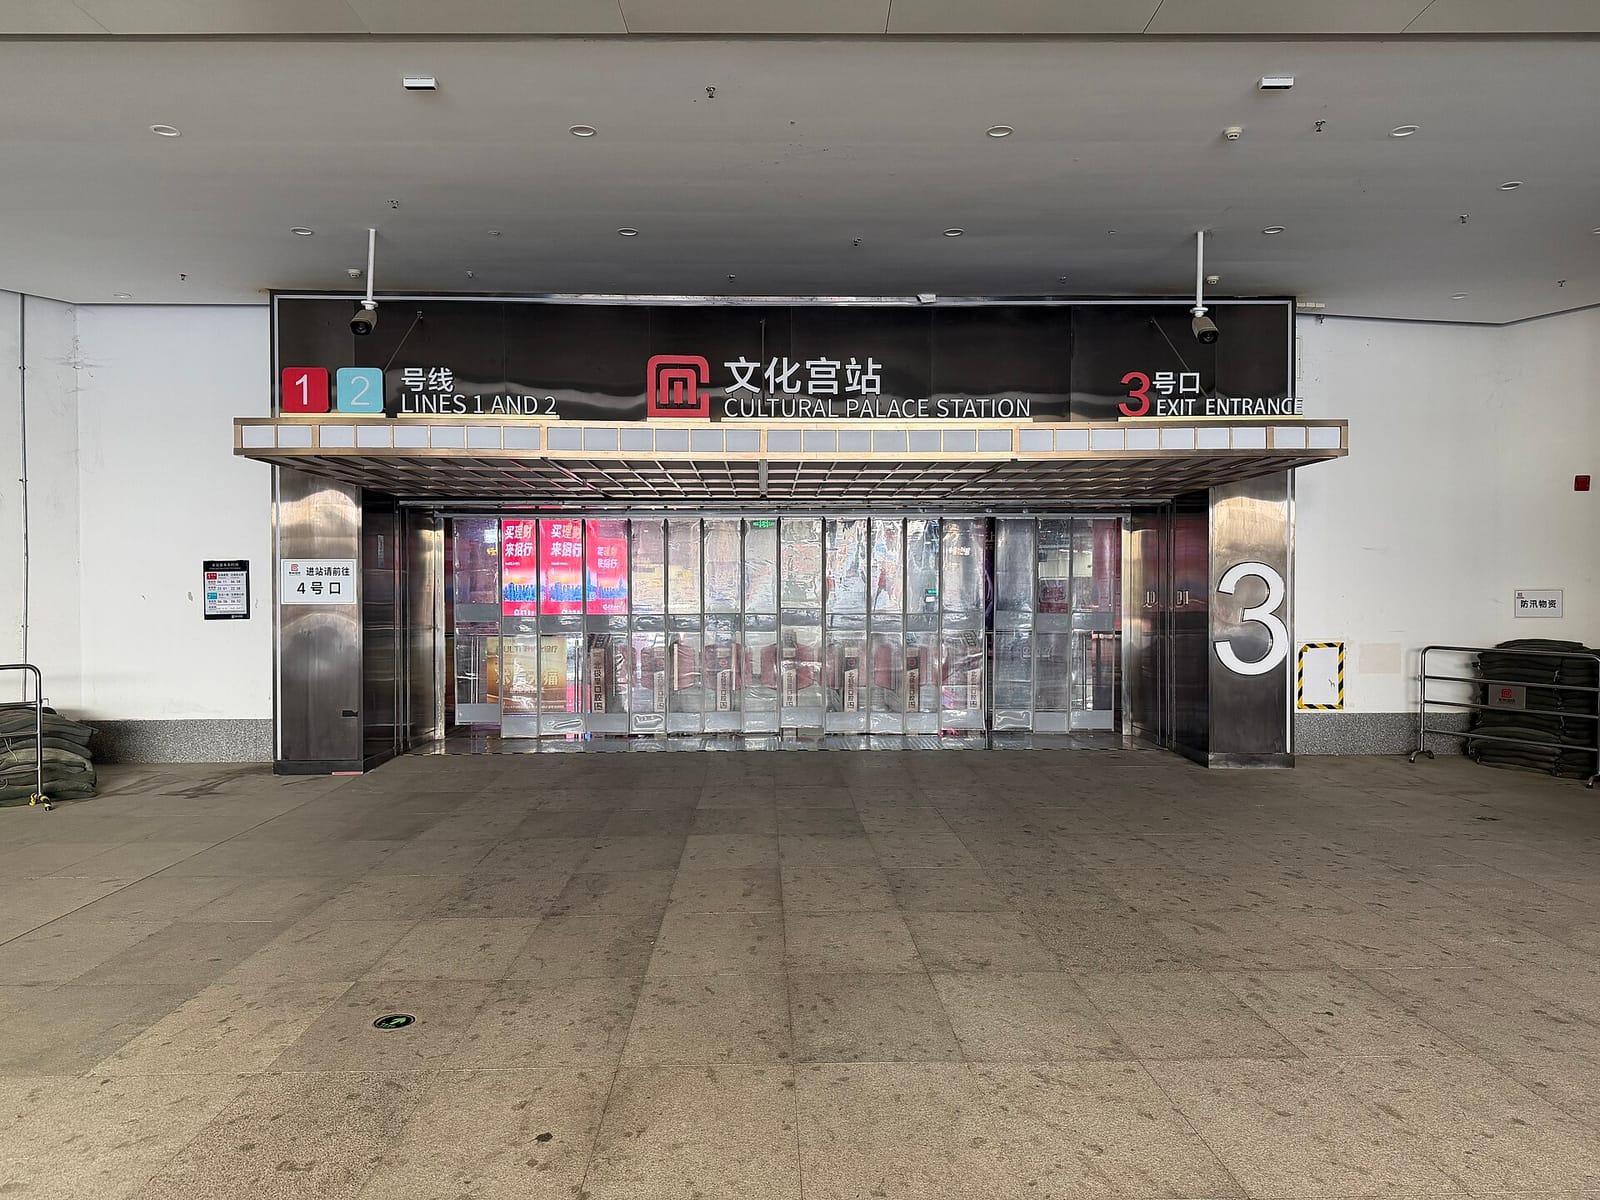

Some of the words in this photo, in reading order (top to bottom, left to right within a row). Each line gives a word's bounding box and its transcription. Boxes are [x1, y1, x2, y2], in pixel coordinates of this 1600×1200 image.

[724, 356, 882, 395] 文化宫站
[295, 374, 308, 406] 1
[350, 375, 370, 406] 2
[401, 367, 454, 392] 号线
[401, 394, 466, 414] LINES
[474, 394, 482, 414] 1
[491, 395, 539, 415] AND
[544, 396, 558, 415] 2
[724, 398, 839, 418] CULTURAL
[846, 398, 929, 418] PALACE
[936, 398, 1031, 418] STATION
[1157, 399, 1196, 416] EXIT
[1205, 397, 1304, 415] ENTRANCE
[306, 567, 350, 577] 进站请前往
[297, 582, 341, 595] 4号口
[1520, 599, 1557, 609] 防汛物资
[1214, 561, 1289, 675] 3
